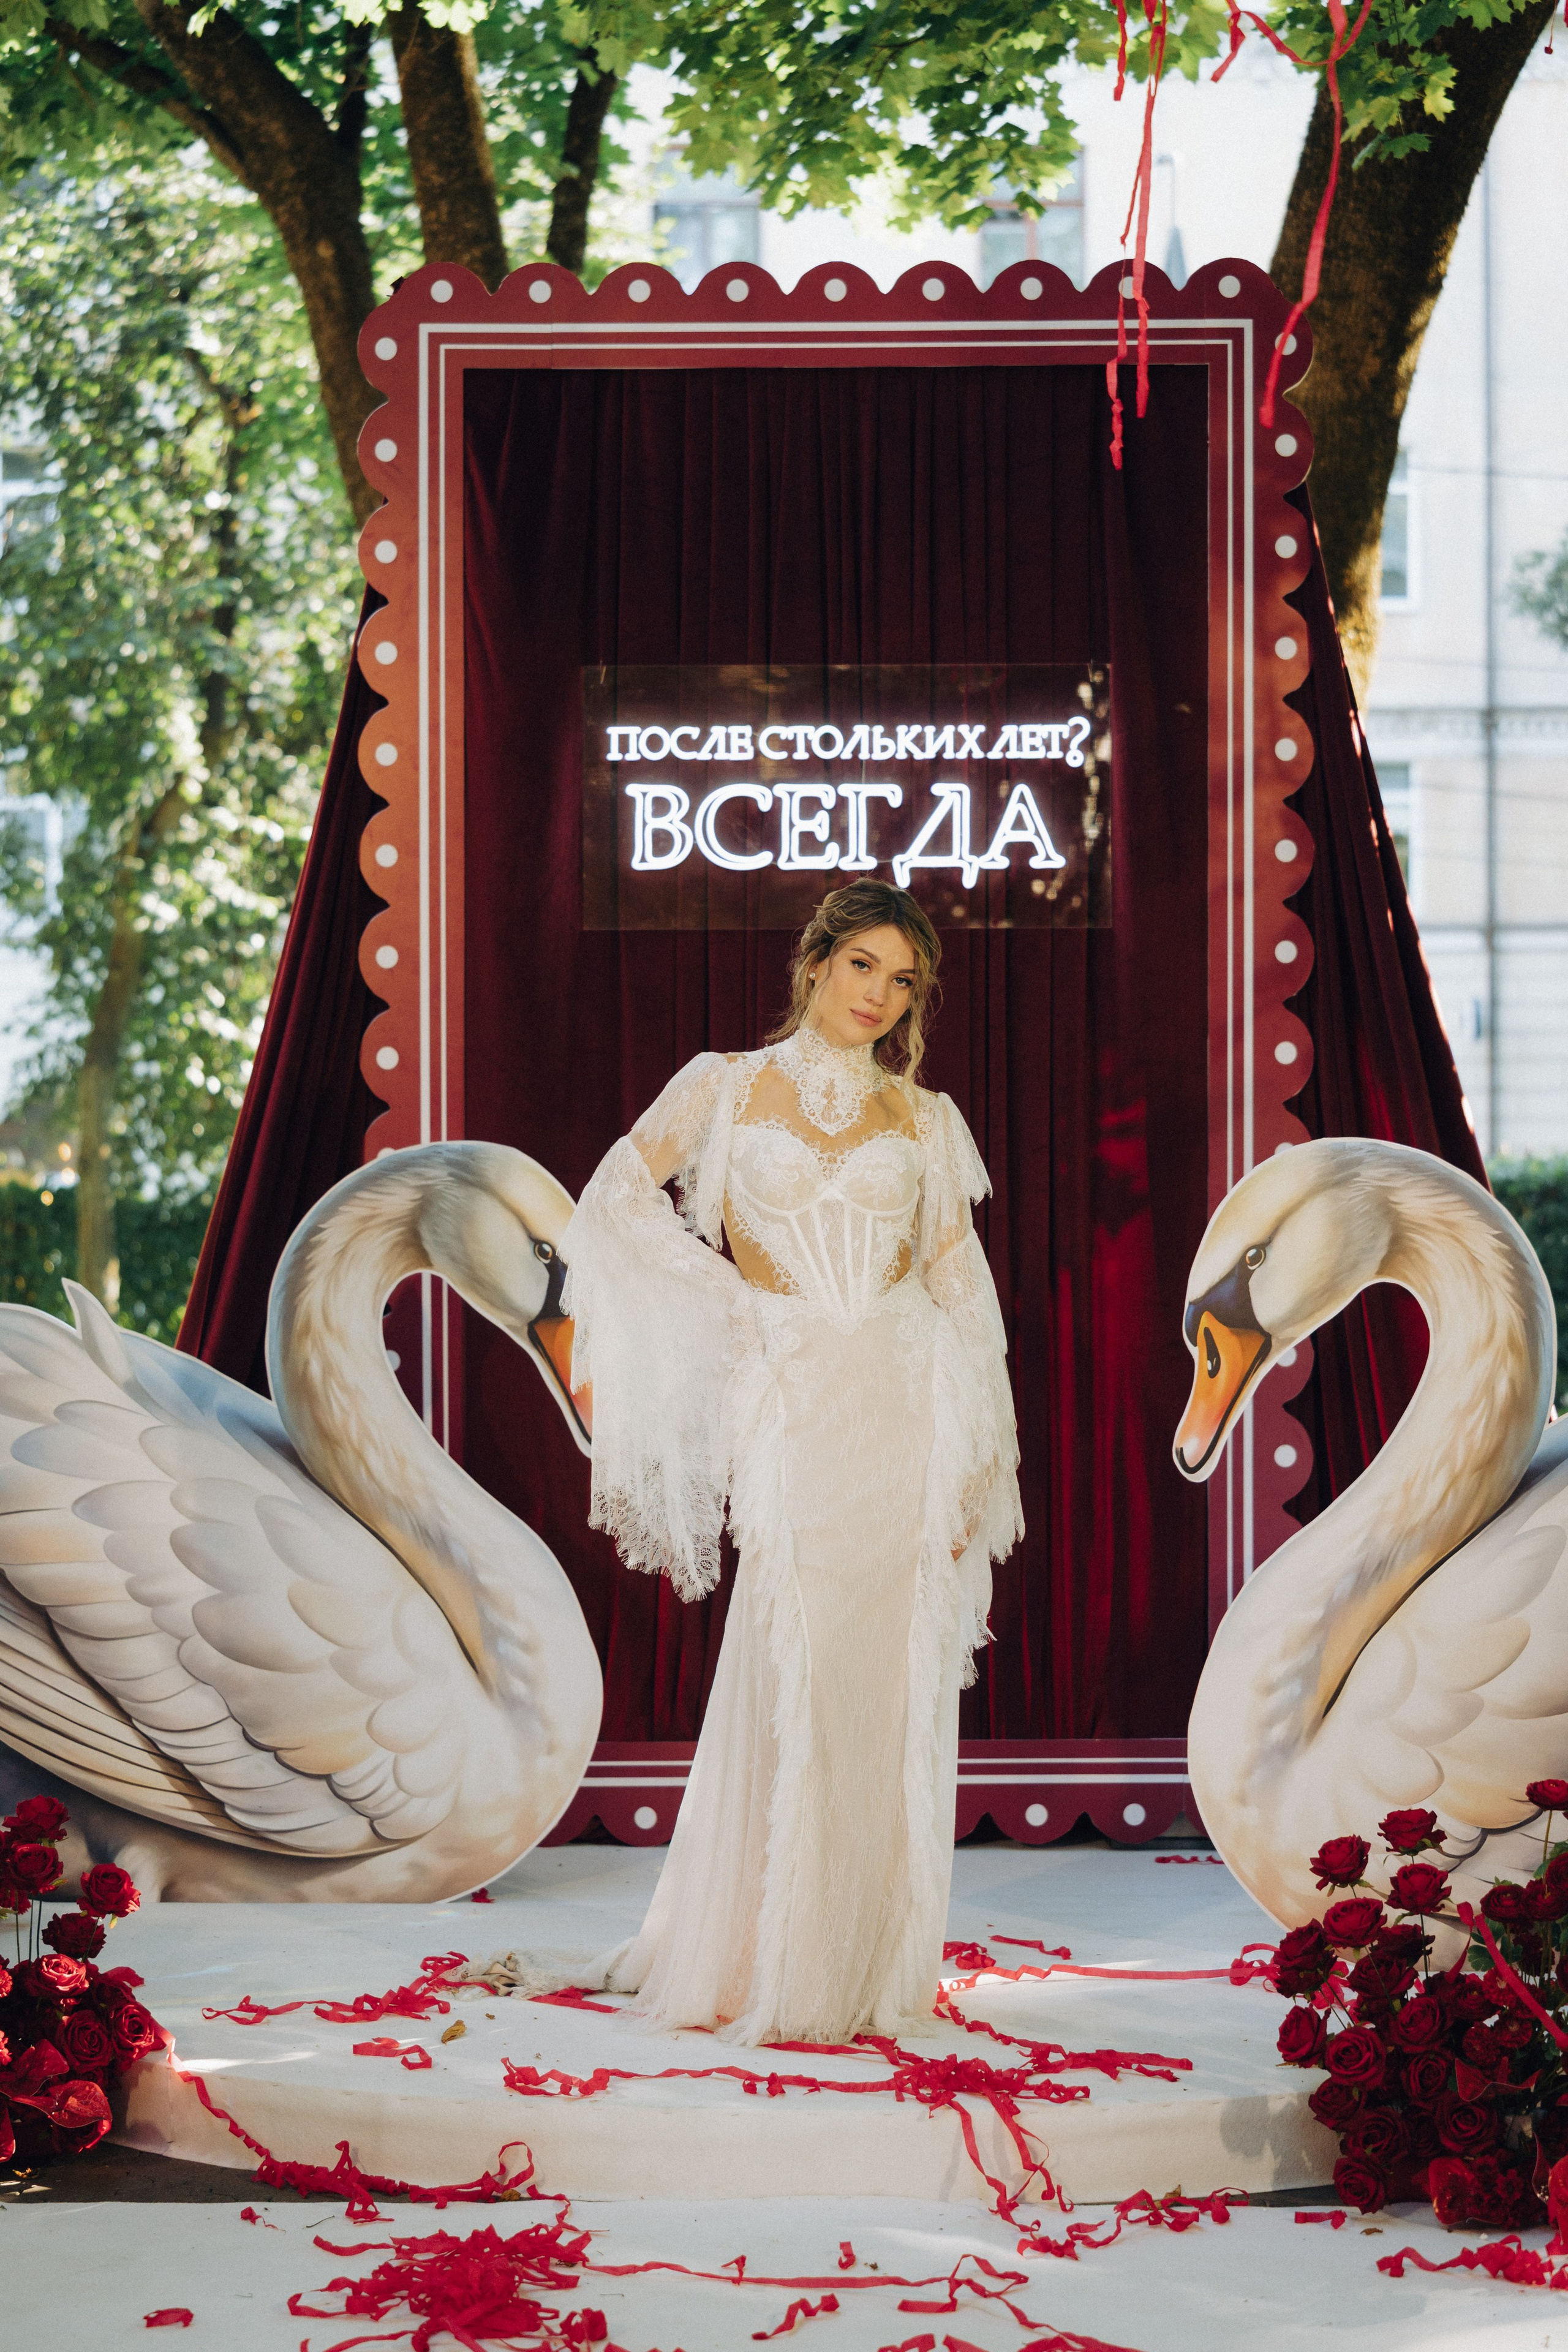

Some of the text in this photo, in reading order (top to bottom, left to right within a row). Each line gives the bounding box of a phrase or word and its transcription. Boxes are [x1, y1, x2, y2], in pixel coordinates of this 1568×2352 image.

[606, 716, 1091, 768] ПОСЛЕ СТОЛЬКИХ ЛЕТ?
[625, 783, 1066, 889] ВСЕГДА
